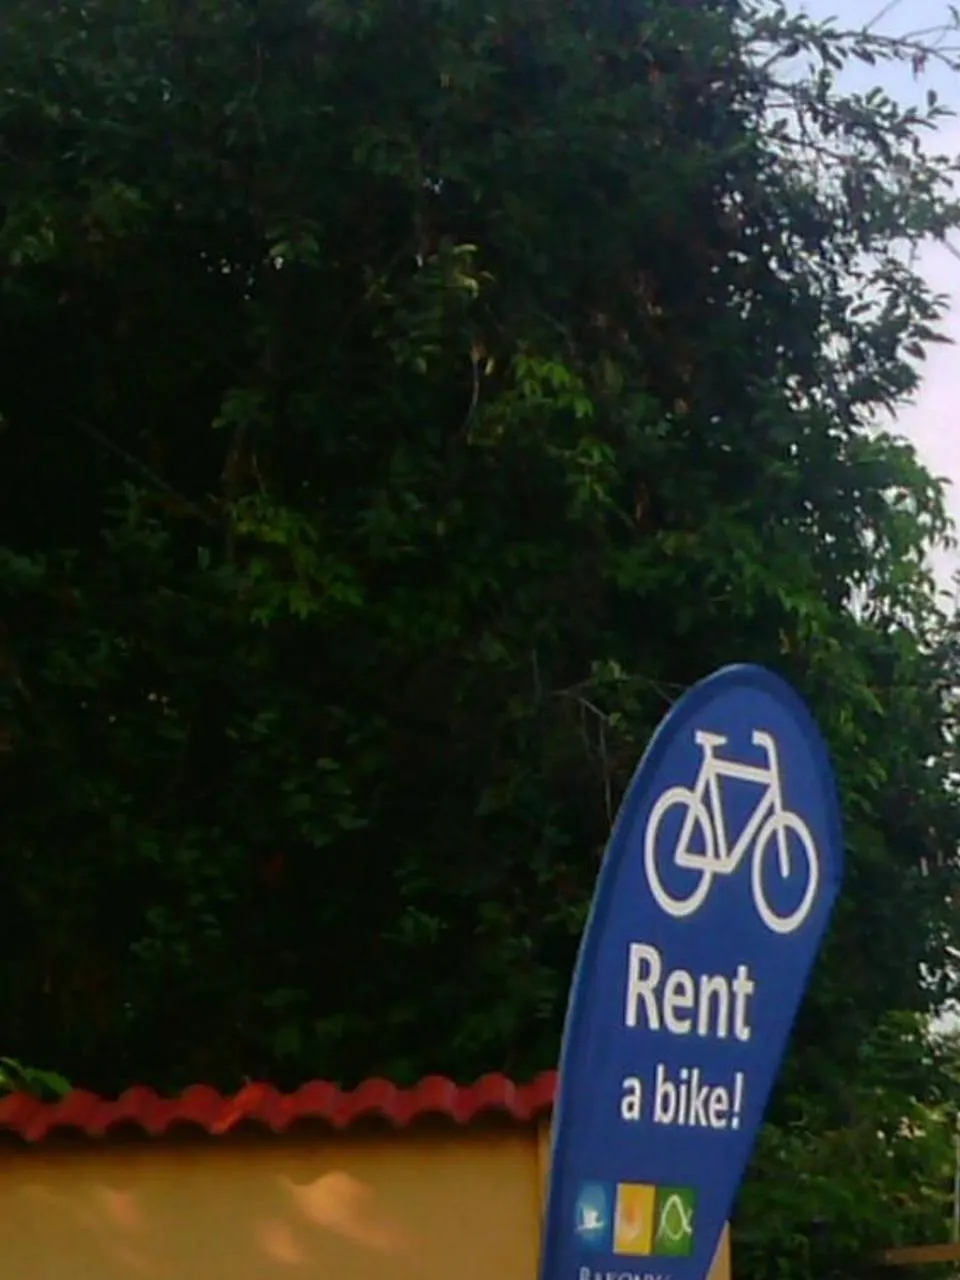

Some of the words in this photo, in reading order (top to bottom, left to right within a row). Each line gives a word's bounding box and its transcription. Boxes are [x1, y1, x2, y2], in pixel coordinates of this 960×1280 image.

[626, 942, 754, 1042] Rent
[621, 1076, 642, 1120] a
[653, 1063, 744, 1129] bike!
